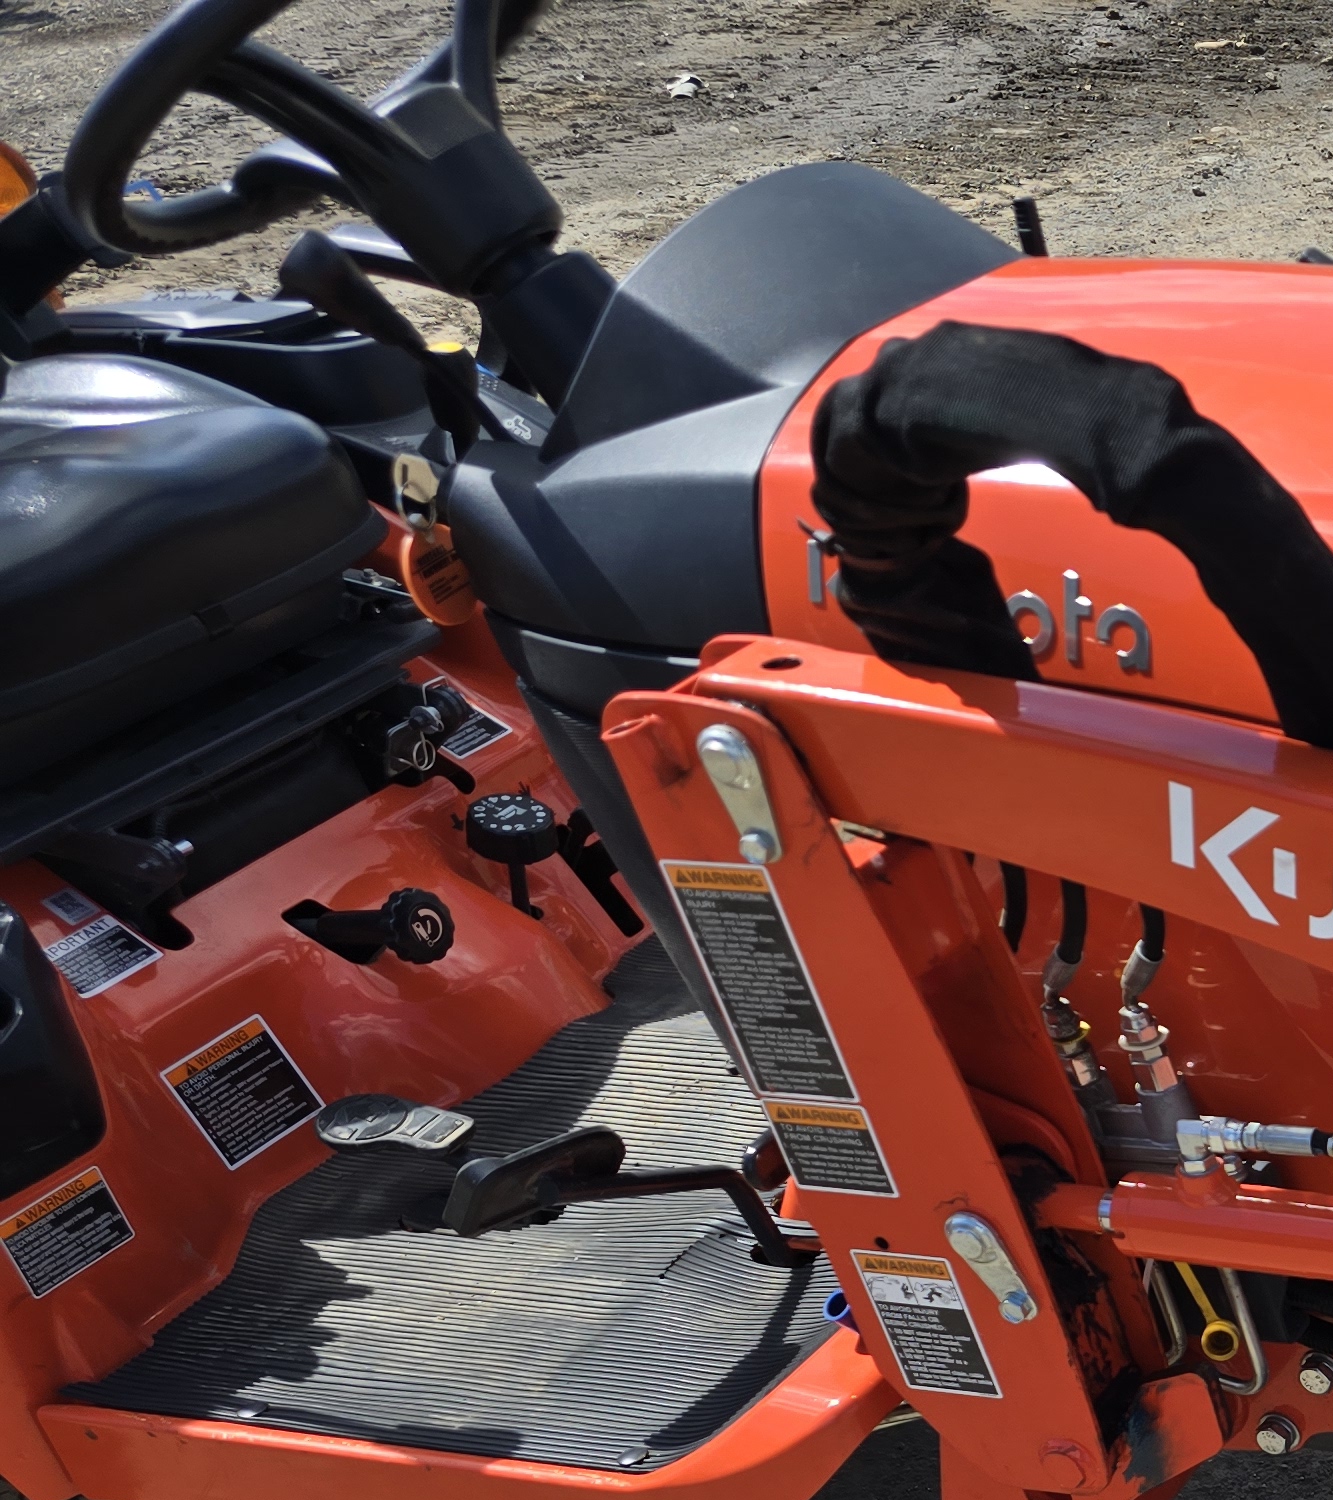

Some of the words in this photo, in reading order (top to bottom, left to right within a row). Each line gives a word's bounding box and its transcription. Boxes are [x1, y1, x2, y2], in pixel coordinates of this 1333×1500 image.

[687, 871, 762, 885] WARNING
[48, 918, 111, 959] PORTANT
[179, 1081, 189, 1090] TO
[188, 1069, 209, 1085] AVOID
[208, 1049, 241, 1072] PERSONAL
[241, 1035, 263, 1052] INJURY
[195, 1029, 249, 1067] WARNING
[787, 1109, 860, 1124] WARNING
[24, 1179, 85, 1221] WARNING
[874, 1258, 944, 1274] WARNING
